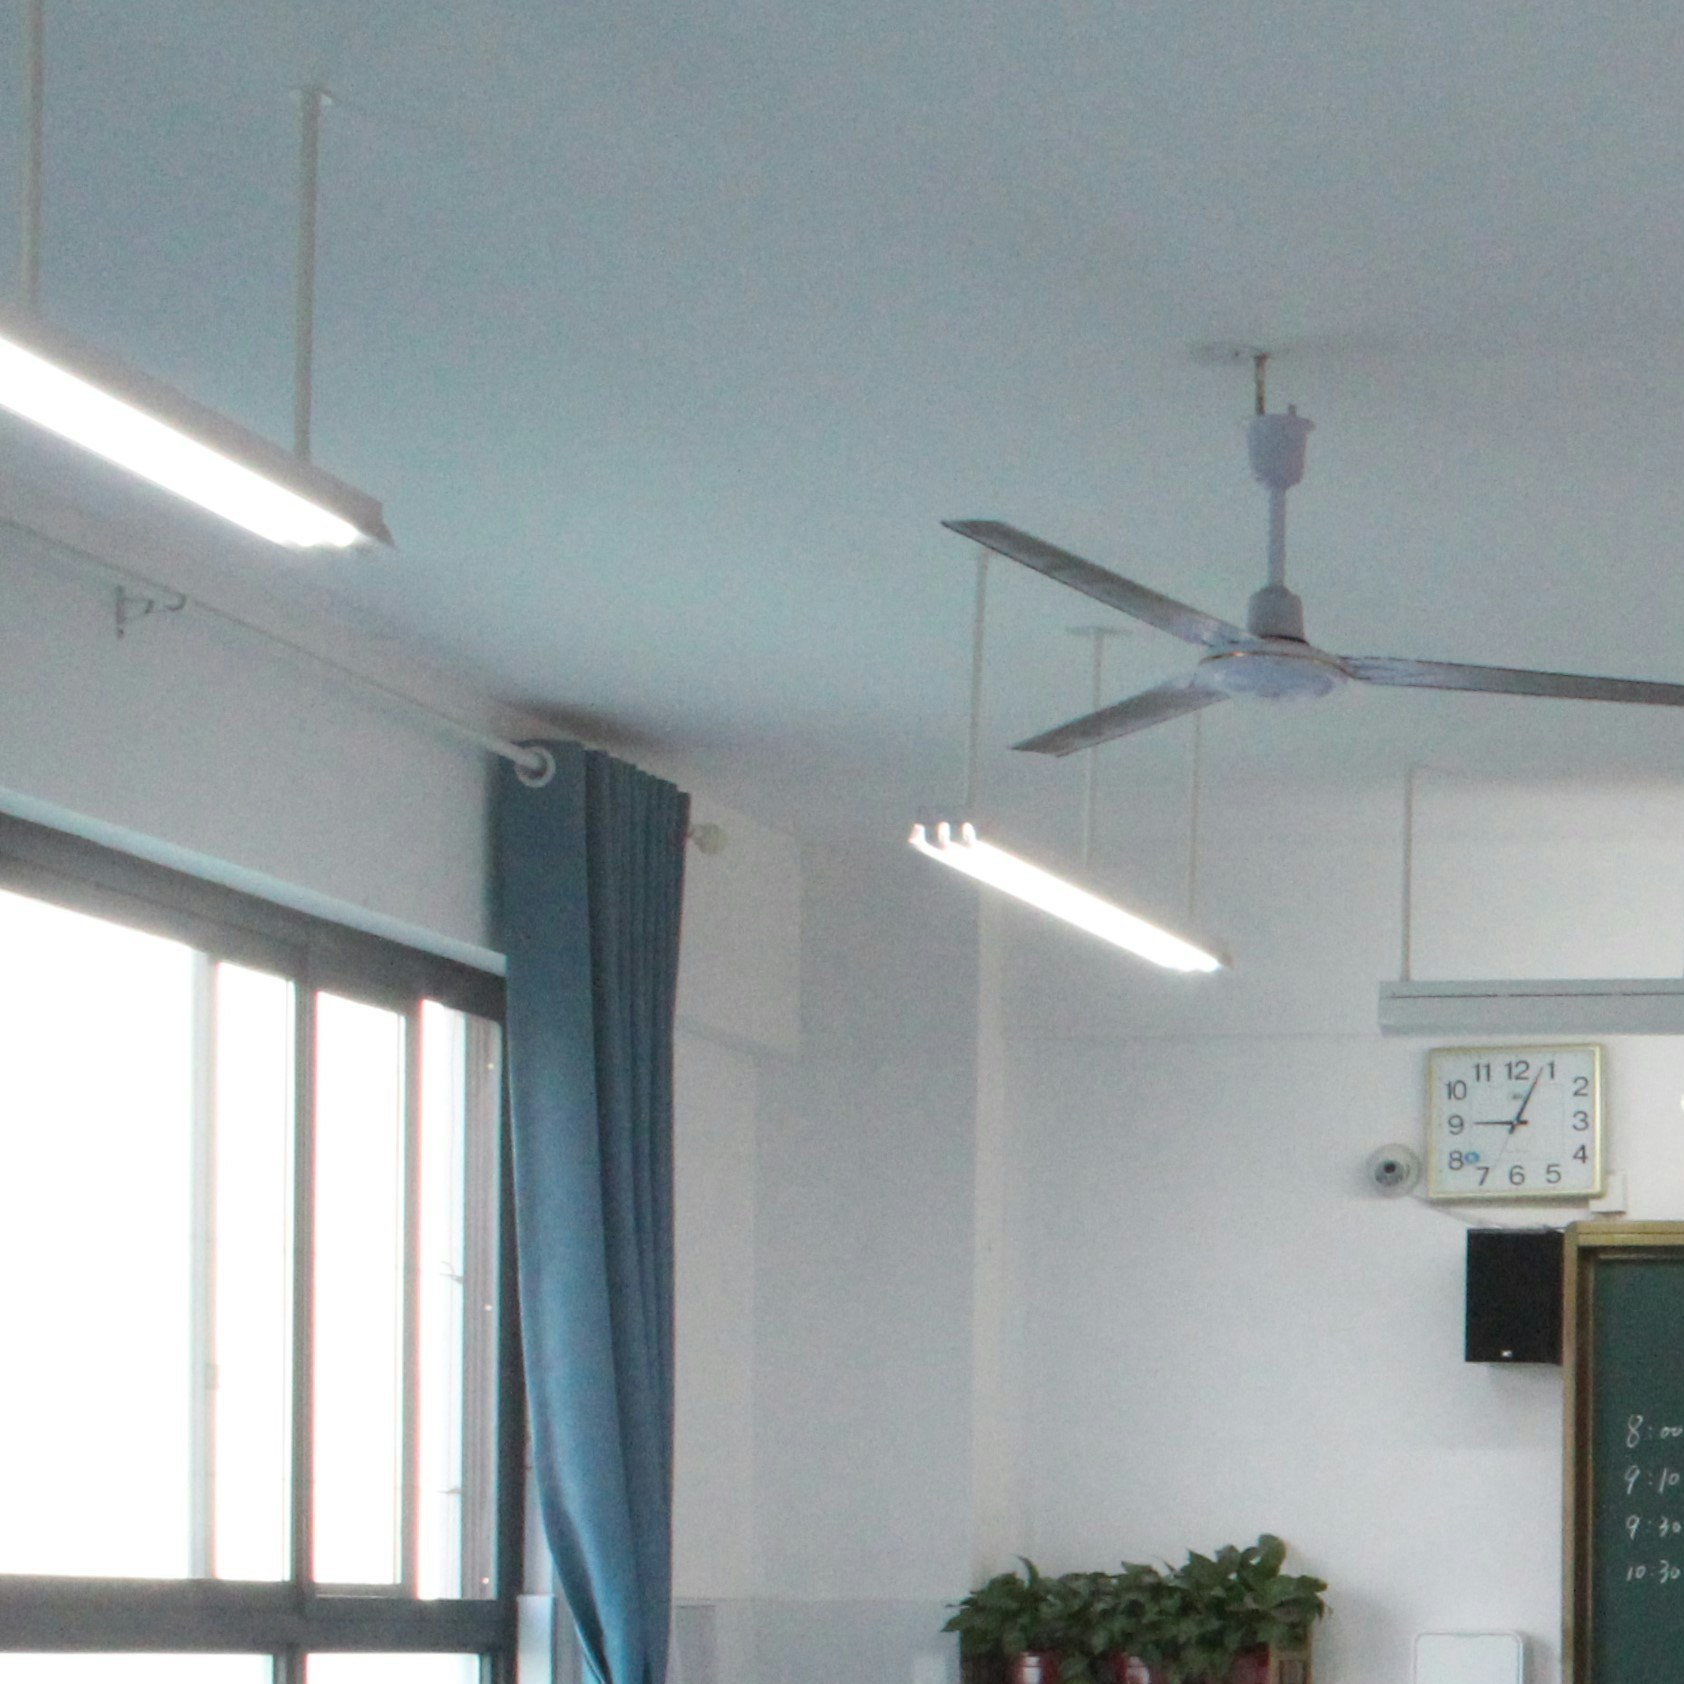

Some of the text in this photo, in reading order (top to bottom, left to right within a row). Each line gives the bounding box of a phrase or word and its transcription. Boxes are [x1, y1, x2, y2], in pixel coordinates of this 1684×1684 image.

[1473, 1063, 1492, 1082] 11
[1505, 1060, 1530, 1080] 12
[1548, 1061, 1555, 1079] 1
[1446, 1080, 1467, 1100] 10
[1573, 1077, 1589, 1096] 2
[1448, 1115, 1464, 1135] 9
[1572, 1111, 1589, 1131] 3
[1449, 1151, 1464, 1170] 8
[1573, 1145, 1589, 1163] 4
[1476, 1167, 1489, 1185] 7
[1509, 1165, 1525, 1185] 6
[1546, 1165, 1562, 1184] 5
